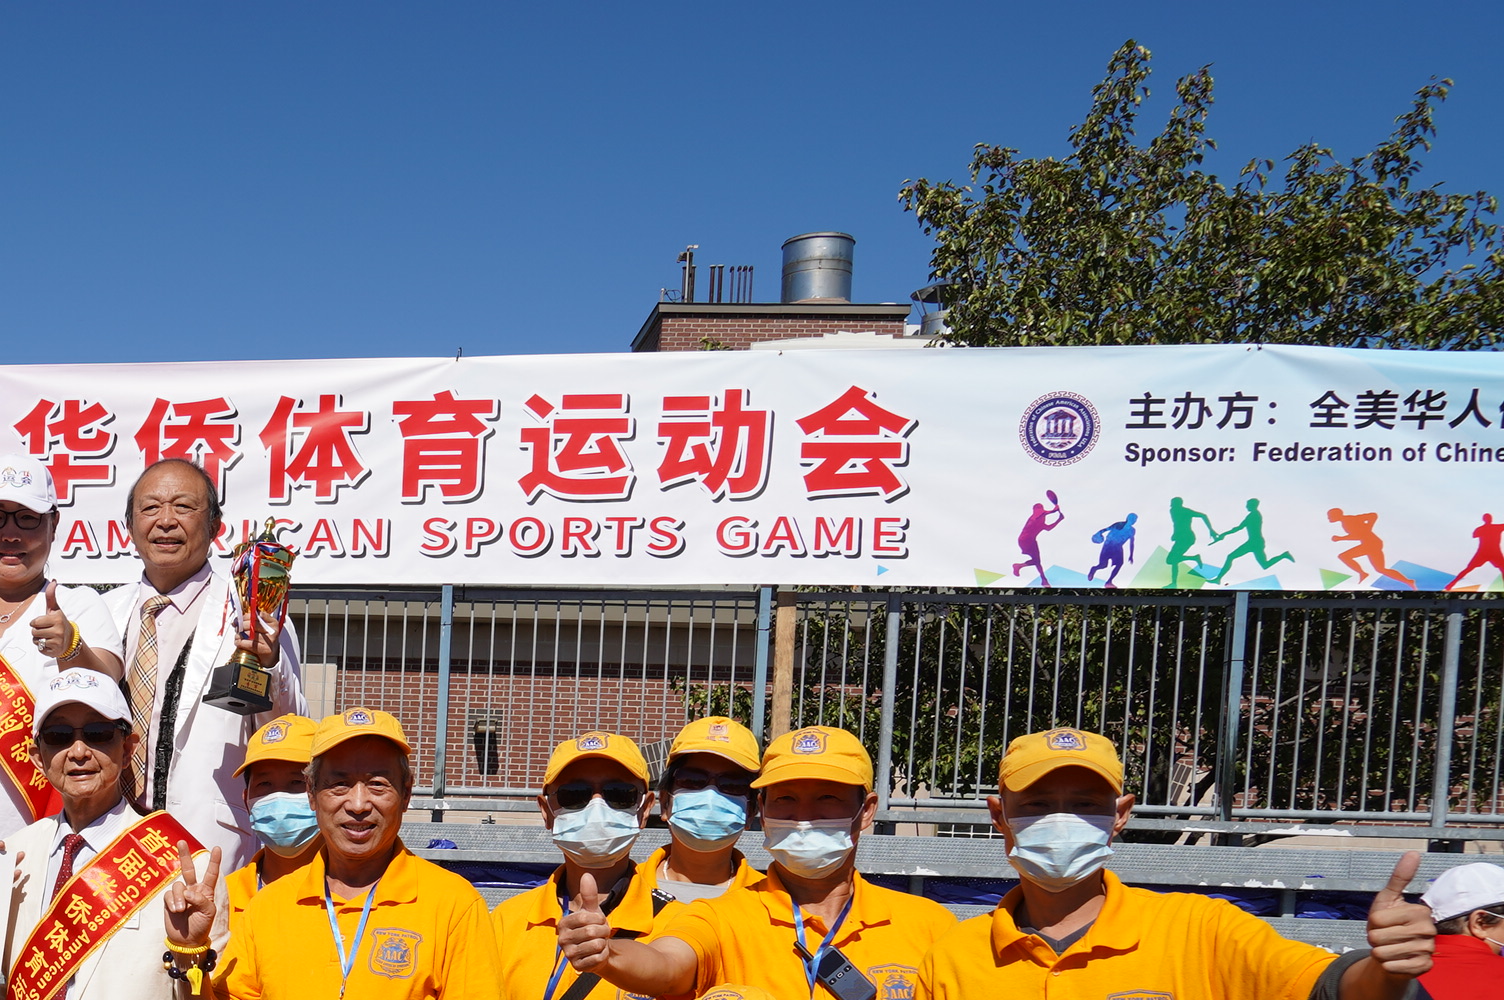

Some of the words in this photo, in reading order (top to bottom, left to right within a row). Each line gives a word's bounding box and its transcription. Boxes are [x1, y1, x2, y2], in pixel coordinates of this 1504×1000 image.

[1125, 388, 1504, 430] 主办方：全美华人
[1125, 442, 1235, 467] Sponsor:
[1252, 441, 1392, 463] Federation
[1402, 442, 1426, 463] of
[419, 515, 688, 558] SPORTS
[715, 514, 909, 558] GAME
[11, 695, 36, 737] Spor
[134, 866, 160, 888] 1st
[87, 885, 141, 932] Chinese
[36, 930, 91, 991] American
[384, 950, 405, 961] AAC
[889, 989, 912, 1000] AAC
